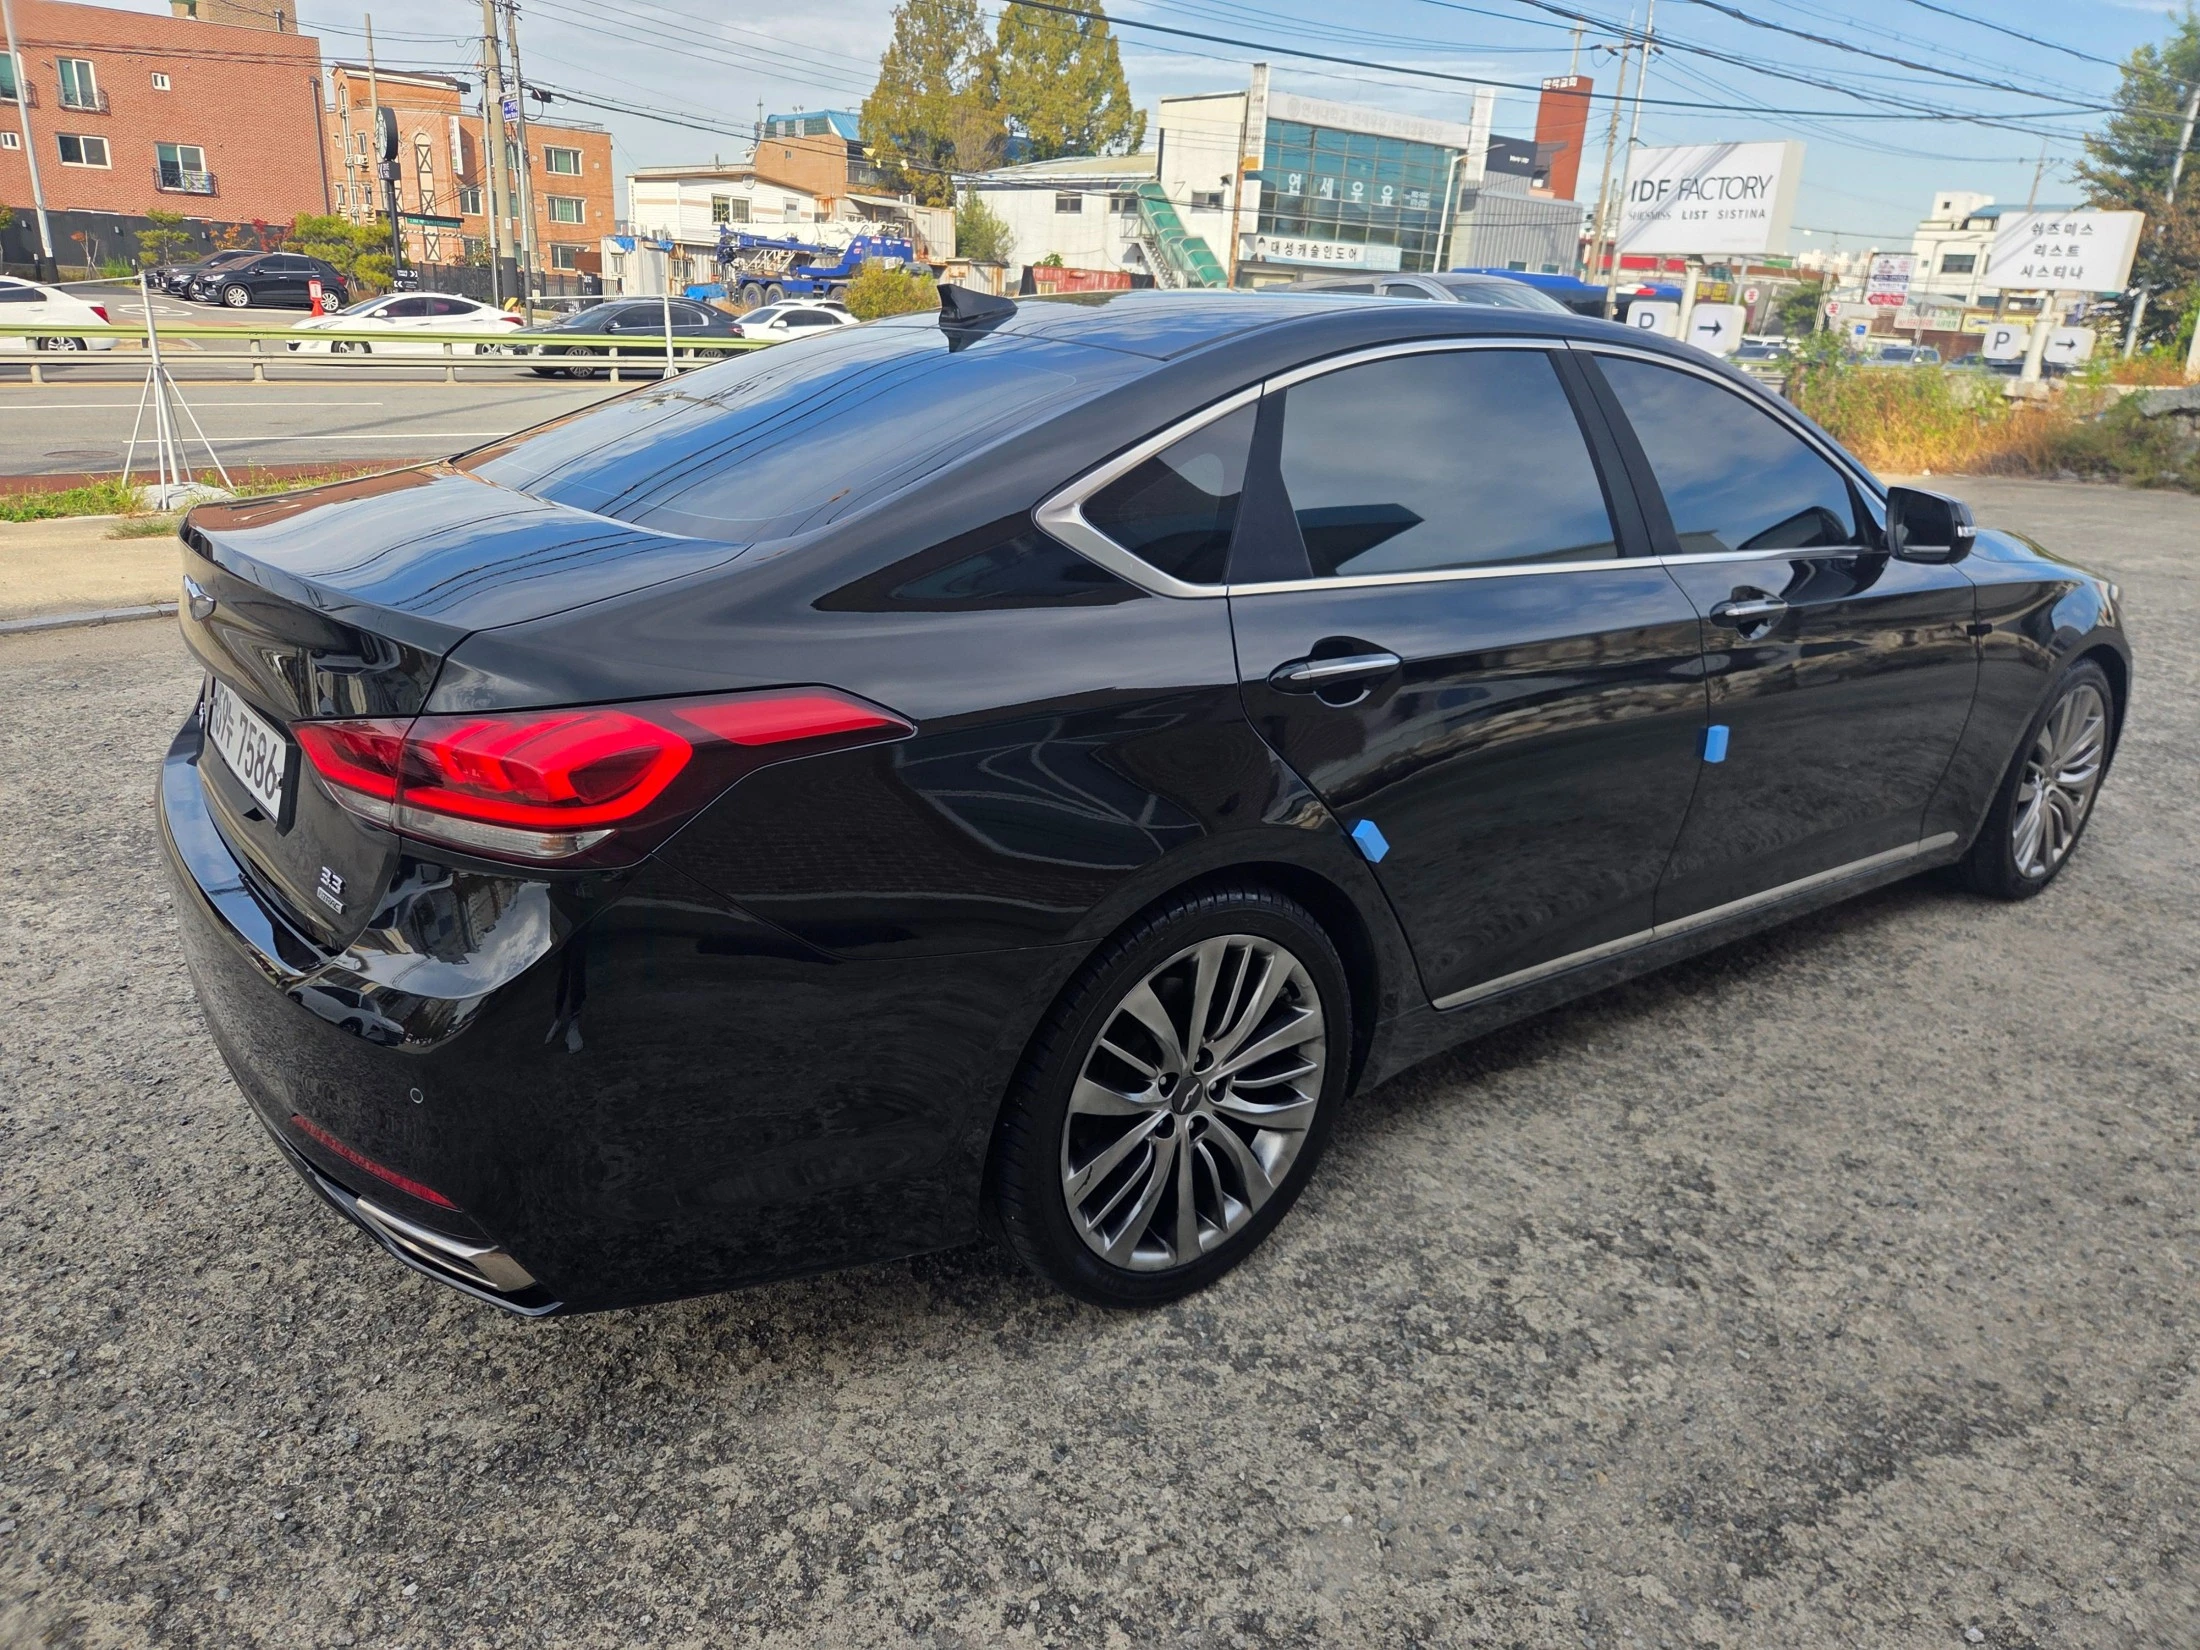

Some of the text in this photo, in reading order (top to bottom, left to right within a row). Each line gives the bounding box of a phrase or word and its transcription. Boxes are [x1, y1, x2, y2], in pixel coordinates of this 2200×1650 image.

[1631, 174, 1774, 202] IDF FACTORY
[1681, 210, 1709, 221] LIST
[1717, 208, 1766, 220] SISTINA
[1270, 240, 1358, 262] 대성캐슬인도어
[2033, 244, 2081, 258] 리스트
[2020, 264, 2084, 280] 시스티나
[1993, 331, 2011, 350] P
[237, 711, 278, 800] 7586
